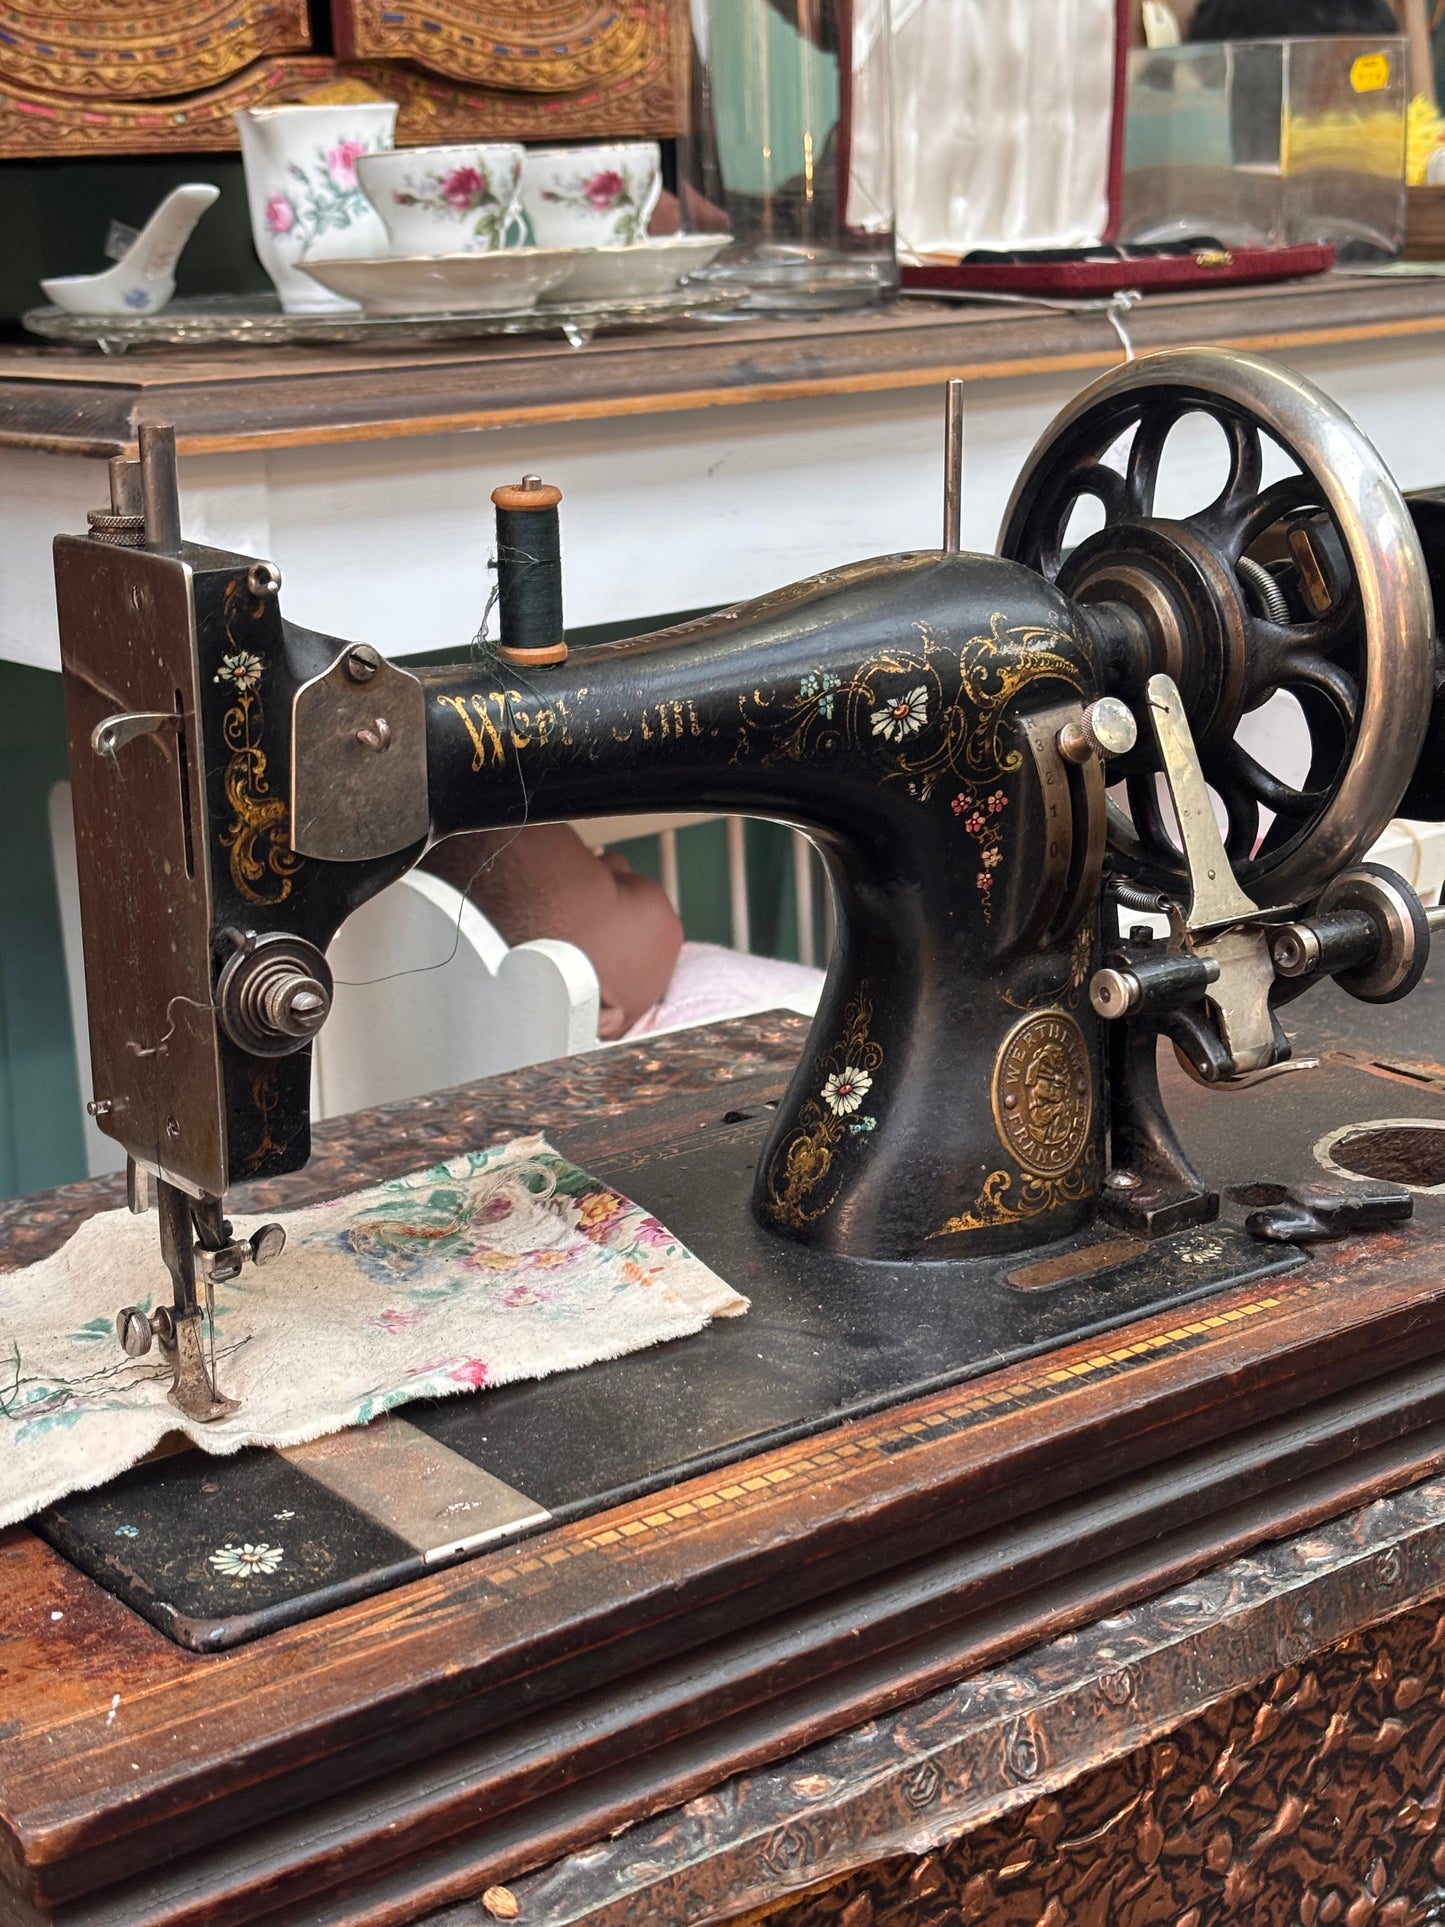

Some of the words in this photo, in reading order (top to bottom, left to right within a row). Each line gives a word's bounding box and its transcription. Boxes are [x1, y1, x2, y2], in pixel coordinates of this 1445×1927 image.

[1035, 738, 1045, 752] 3
[1045, 771, 1054, 785] 2
[1050, 804, 1058, 818] 1
[1006, 1023, 1083, 1085] WERTHEIM
